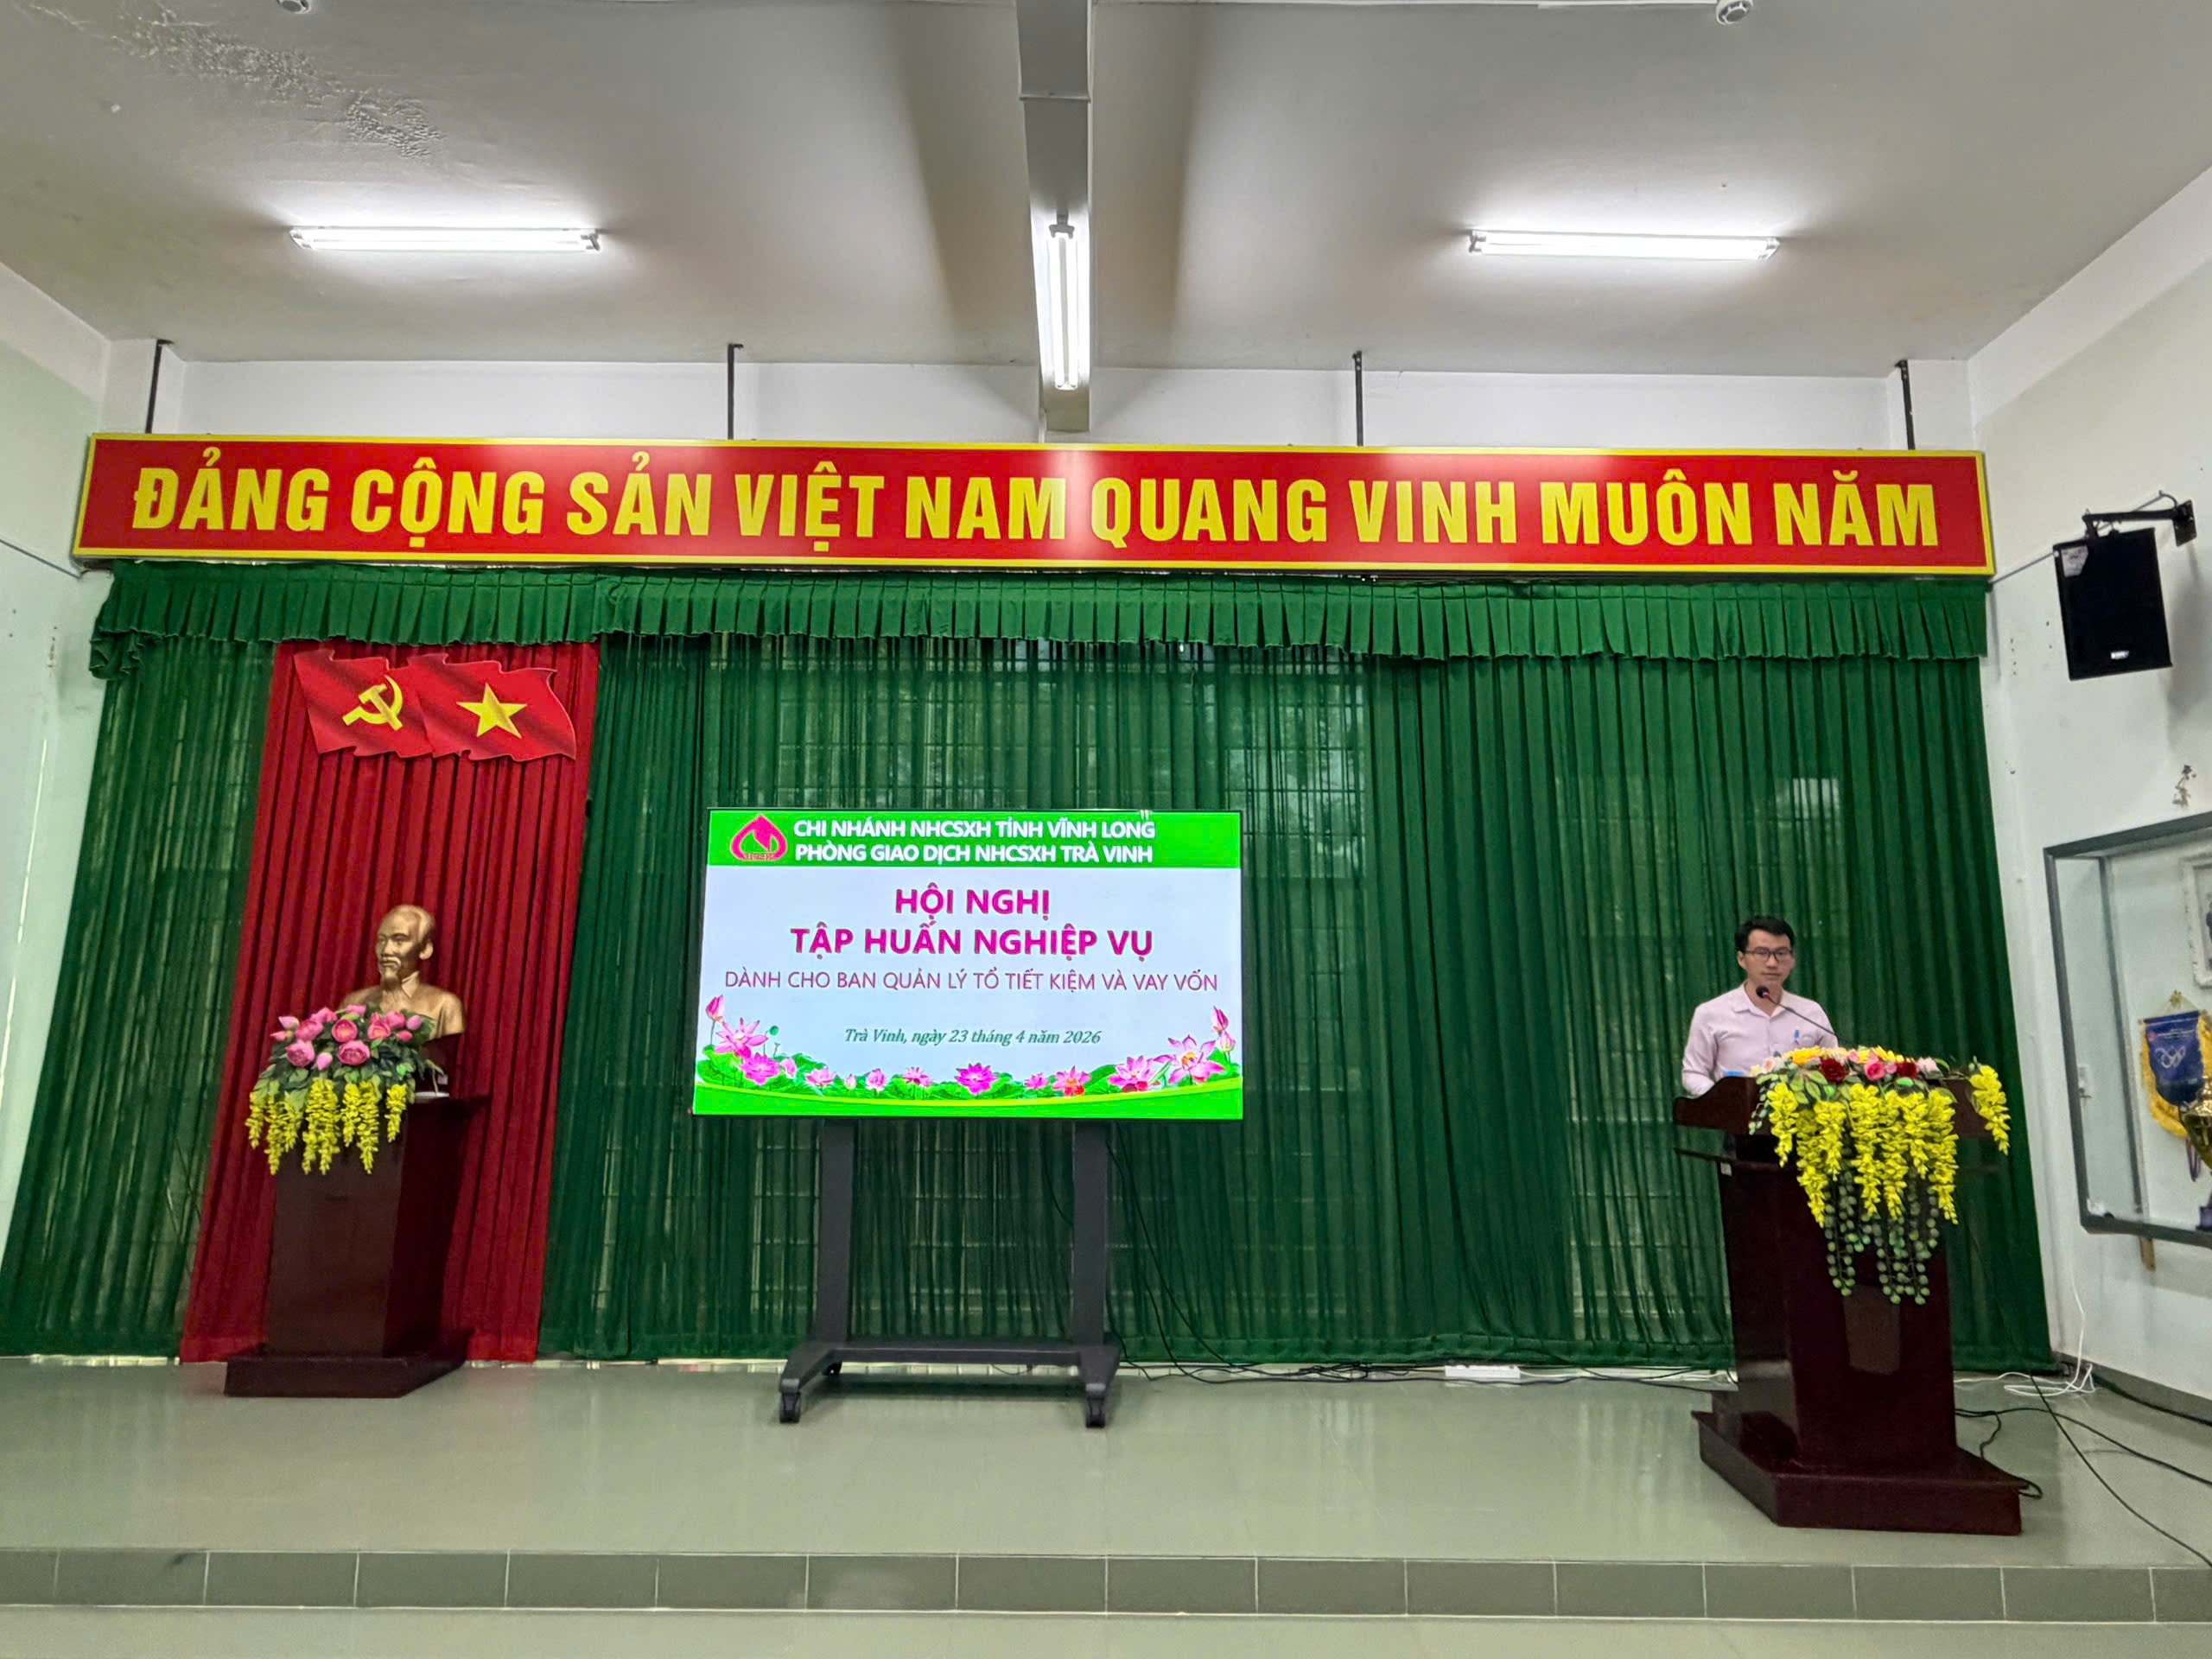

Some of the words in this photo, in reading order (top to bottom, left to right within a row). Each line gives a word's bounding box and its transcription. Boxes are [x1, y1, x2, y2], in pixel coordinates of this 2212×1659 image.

[132, 447, 330, 531] ĐẢNG
[351, 457, 545, 548] CỘNG
[567, 451, 712, 536] SẢN
[734, 461, 884, 552] VIỆT
[905, 476, 1066, 540] NAM
[1090, 477, 1327, 549] QUANG
[1349, 480, 1516, 544] VINH
[1540, 468, 1753, 546] MUÔN
[1773, 469, 1939, 547] NĂM
[793, 820, 827, 837] CHI
[831, 817, 906, 837] NHÁNH
[910, 820, 991, 837] NHCSXH
[1047, 817, 1096, 838] VĨNH
[1102, 821, 1155, 839] LONG
[795, 840, 866, 861] PHÒNG
[871, 844, 919, 861] GIAO
[924, 845, 970, 865] DỊCH
[975, 845, 1056, 862] NHCSXH
[1060, 841, 1099, 862] TRÀ
[1103, 845, 1153, 863] VINH
[895, 882, 954, 920] HỘI
[966, 889, 1049, 921] NGHỊ
[790, 921, 854, 960] TẬP
[864, 920, 961, 955] HUẤN
[974, 923, 1097, 962] NGHIỆP
[1107, 930, 1154, 962] VỤ
[725, 966, 781, 988] DÀNH
[787, 971, 830, 988] CHO
[836, 972, 876, 989] BAN
[883, 968, 941, 990] QUẢN
[948, 968, 967, 989] LÝ
[973, 966, 999, 989] TỔ
[1005, 968, 1044, 990] TIẾT
[1050, 969, 1096, 993] KIỆM
[1102, 969, 1127, 990] VÀ
[1133, 974, 1168, 991] VAY
[1173, 969, 1217, 991] VỐN
[845, 1028, 868, 1042] Trà
[873, 1028, 907, 1044] Vinh,
[912, 1031, 947, 1046] ngày
[949, 1029, 969, 1043] 23
[971, 1029, 1013, 1046] tháng
[1015, 1030, 1026, 1043] 4
[1027, 1030, 1059, 1044] năm
[1063, 1030, 1102, 1044] 2026
